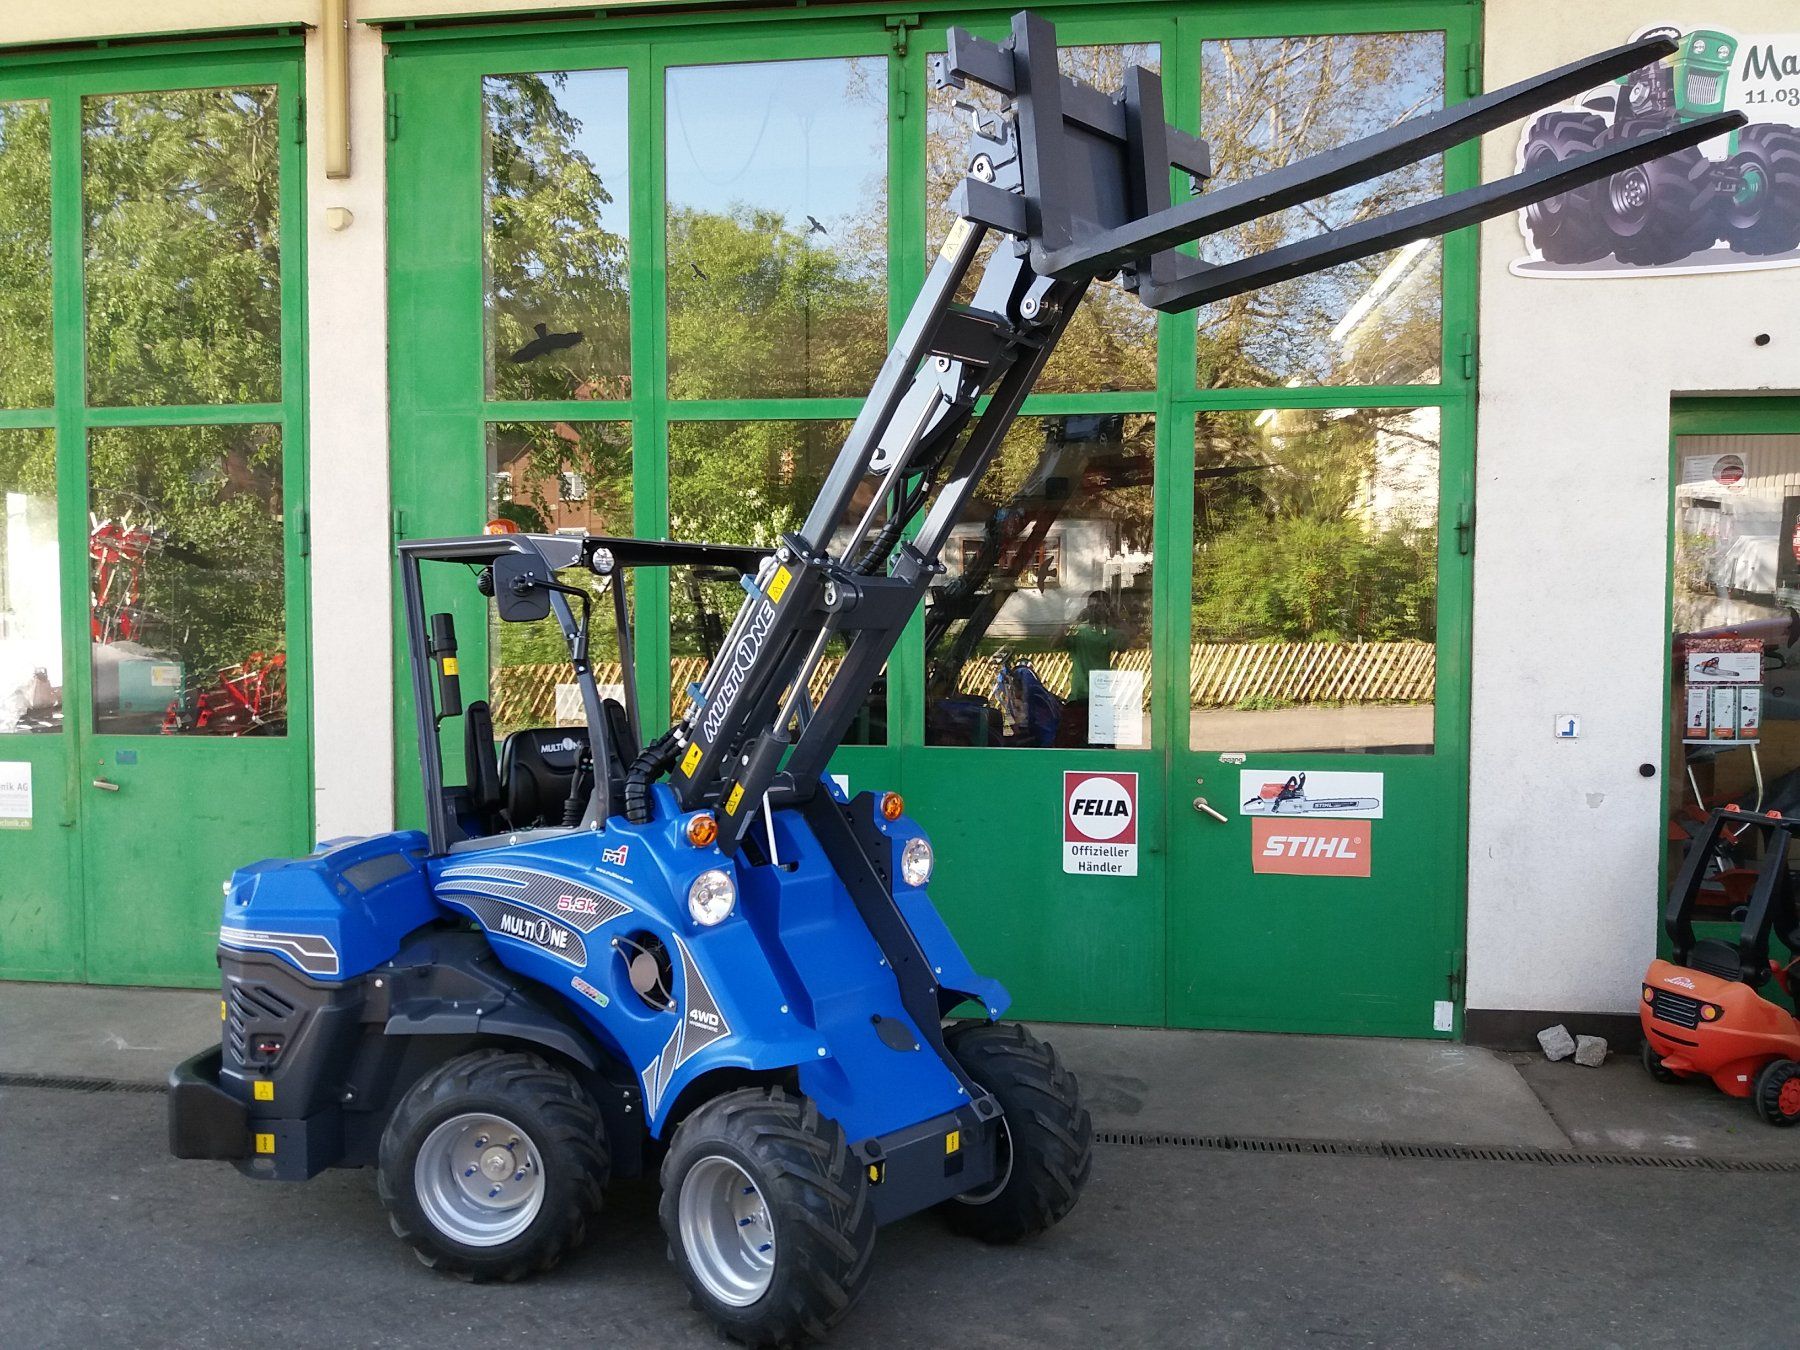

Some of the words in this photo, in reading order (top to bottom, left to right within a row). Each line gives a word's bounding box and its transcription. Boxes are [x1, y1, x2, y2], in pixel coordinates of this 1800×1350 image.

[17, 782, 28, 791] AG
[1072, 798, 1129, 817] FELLA
[1071, 845, 1129, 857] Offizieller
[1262, 835, 1357, 859] STIHL
[1078, 861, 1122, 872] Händler
[557, 895, 599, 914] 5.3k
[1663, 976, 1696, 990] Linde
[689, 1008, 719, 1026] 4WD
